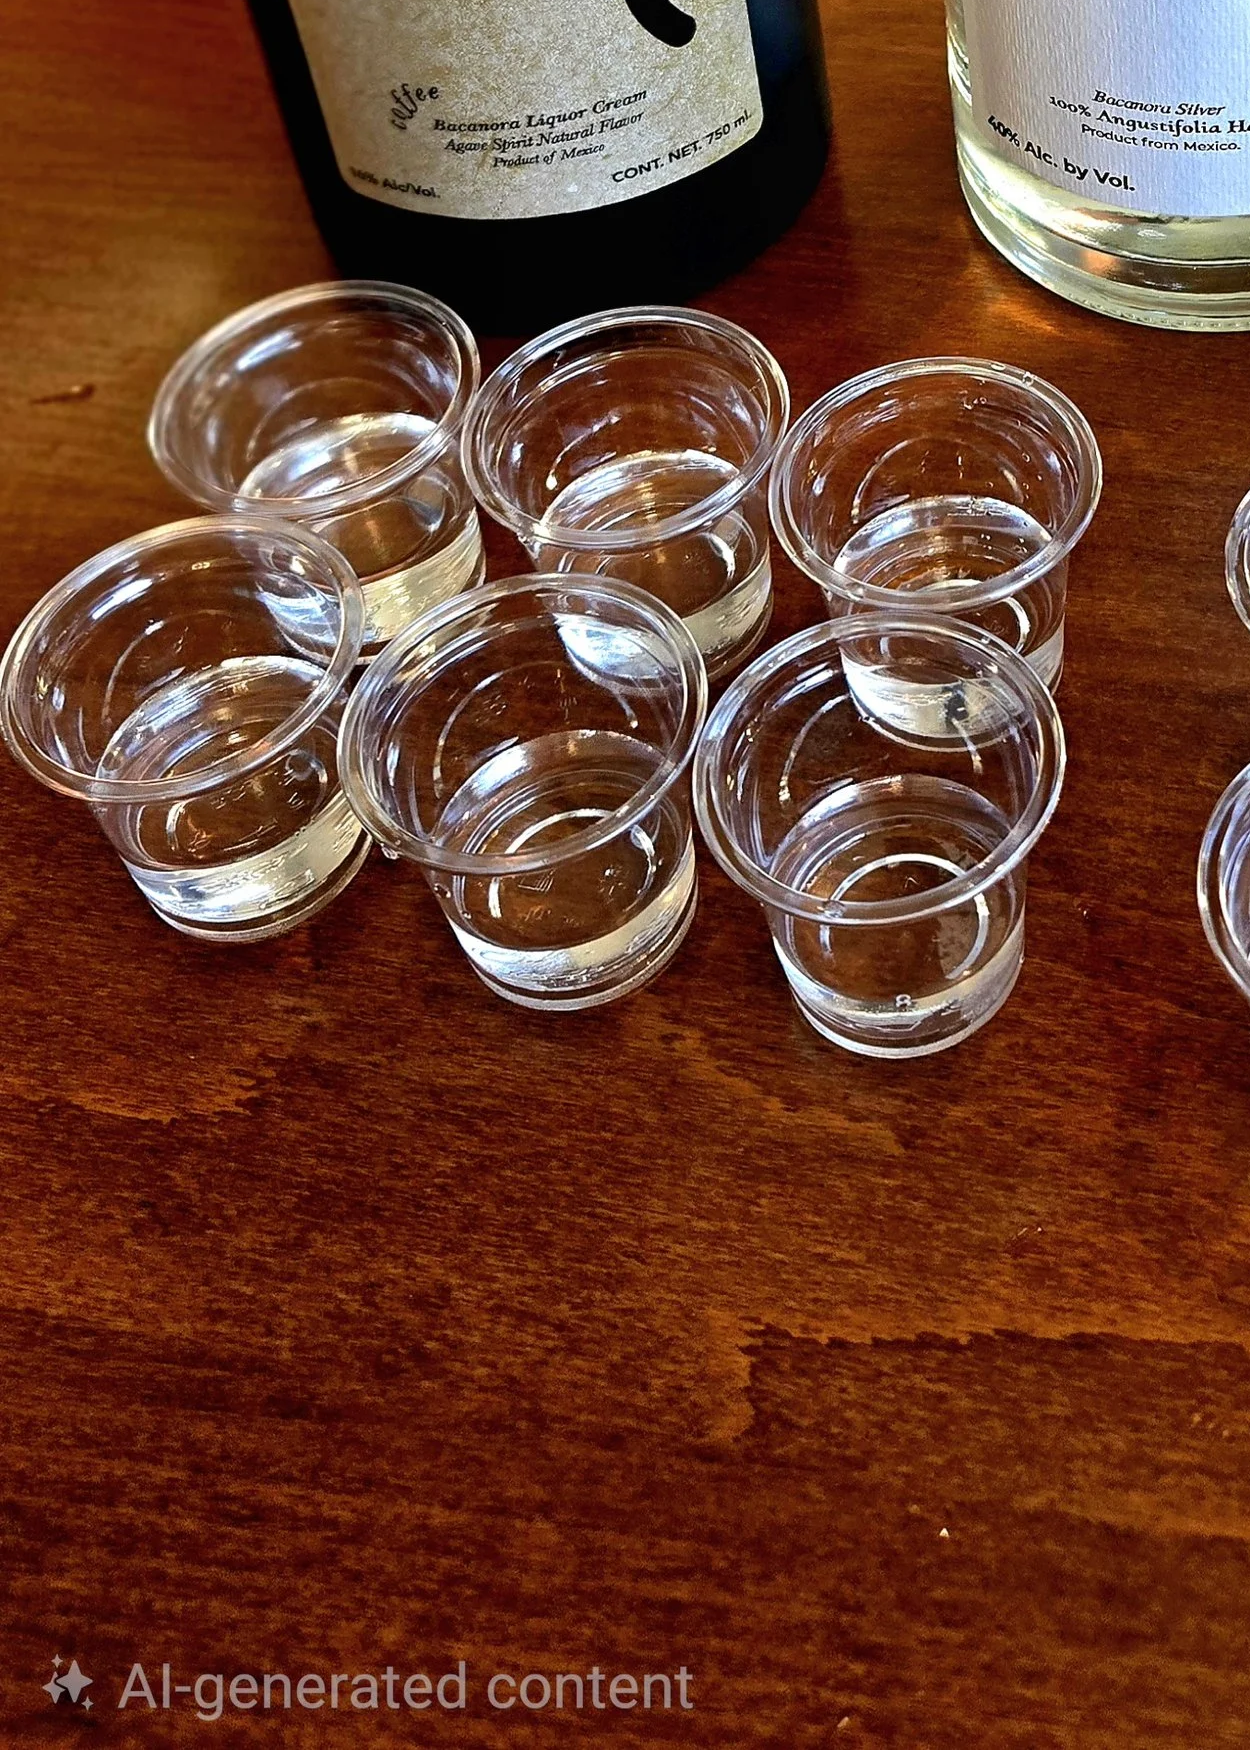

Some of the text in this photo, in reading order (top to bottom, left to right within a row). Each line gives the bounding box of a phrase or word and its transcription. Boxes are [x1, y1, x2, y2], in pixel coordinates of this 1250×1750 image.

[432, 89, 648, 132] Bacanora Liquor Cream
[1049, 95, 1092, 118] 100%
[1096, 109, 1223, 138] Angustifolia
[1091, 89, 1227, 117] Bacanora Silver
[443, 110, 645, 155] Agave Spirit Natural Flavor
[611, 156, 665, 184] CONT.
[667, 139, 703, 164] NET.
[705, 122, 731, 146] 750
[1081, 123, 1242, 152] Product from Mexico.
[492, 143, 606, 168] Product of Mexico
[1024, 141, 1059, 168] Alc.
[1063, 157, 1089, 181] by
[1093, 168, 1137, 192] Vol.
